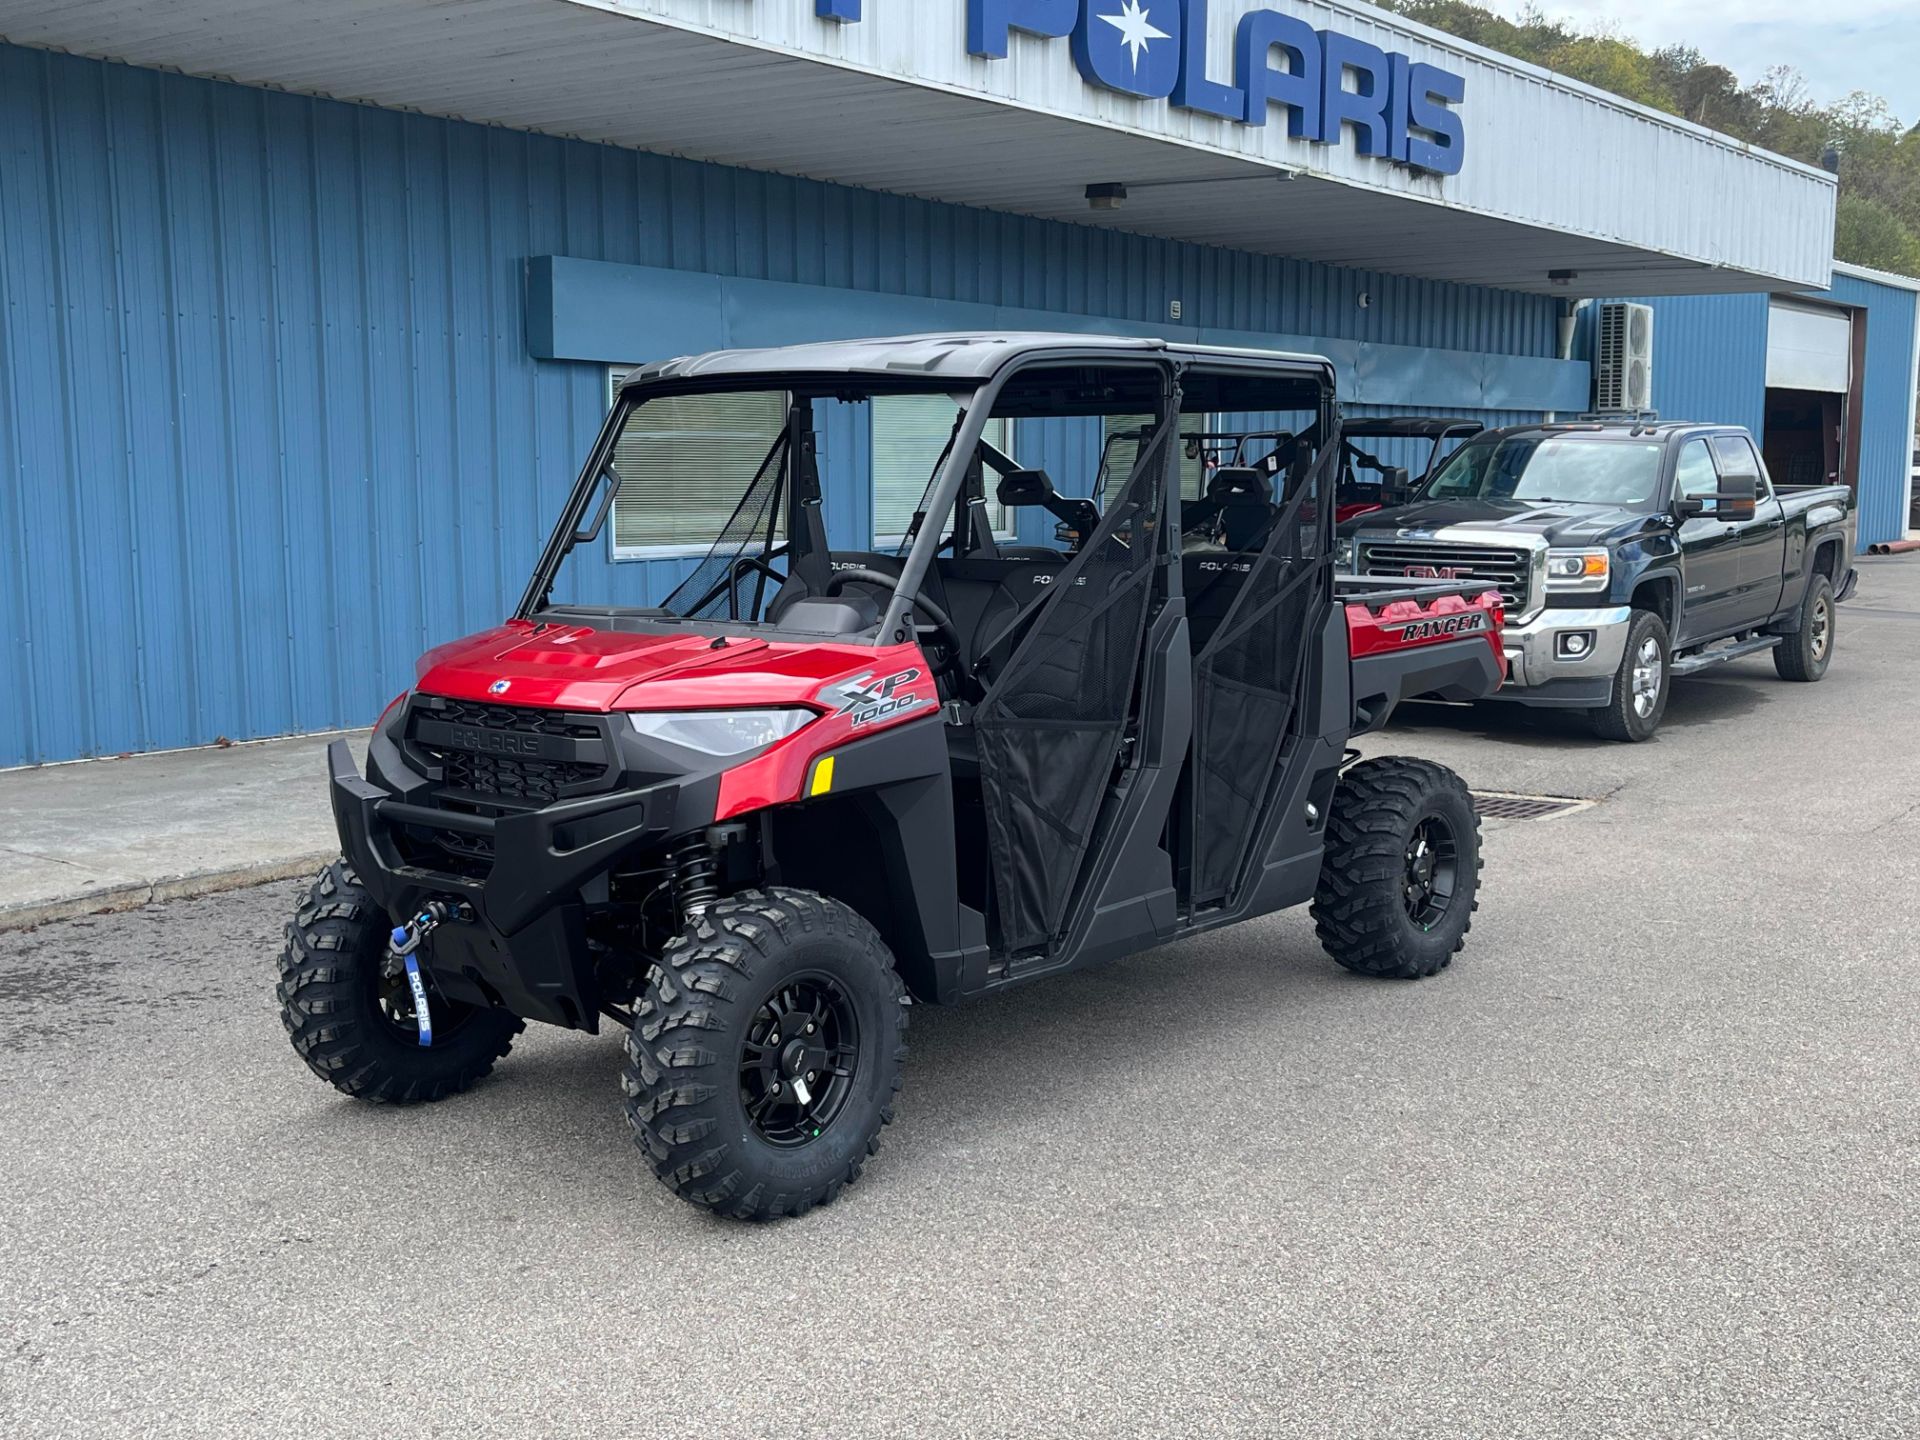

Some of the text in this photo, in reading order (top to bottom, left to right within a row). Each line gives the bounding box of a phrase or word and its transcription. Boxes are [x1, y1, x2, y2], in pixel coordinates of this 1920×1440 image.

[1401, 613, 1482, 641] RANGER
[833, 668, 921, 718] XP
[852, 693, 915, 726] 1000
[450, 727, 539, 756] POLARIS
[410, 971, 430, 1032] POLARIS
